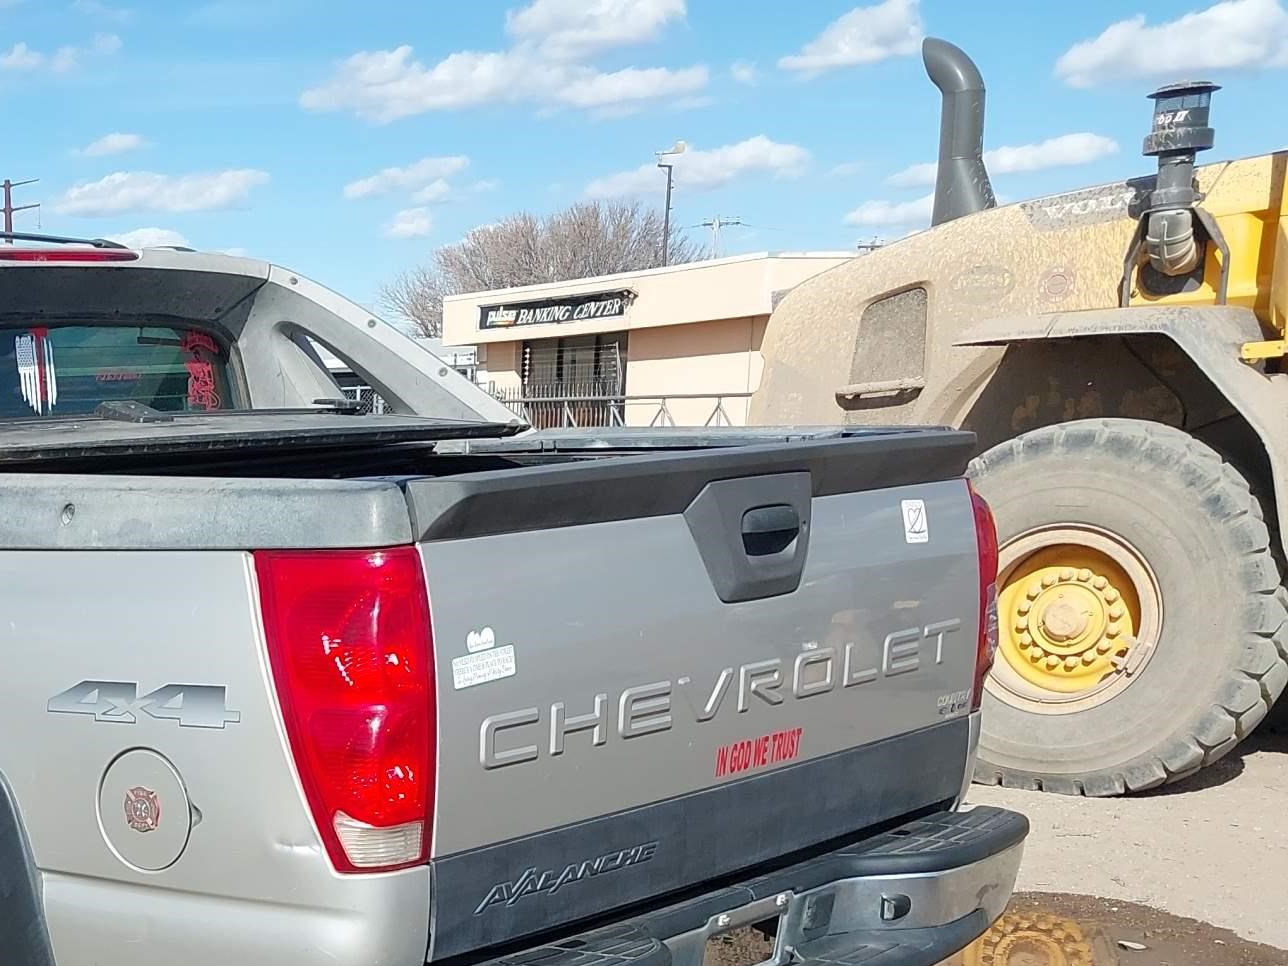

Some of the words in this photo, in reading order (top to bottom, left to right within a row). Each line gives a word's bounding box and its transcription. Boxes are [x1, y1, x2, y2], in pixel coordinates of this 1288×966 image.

[518, 304, 571, 325] BANKING
[573, 298, 621, 319] CENTER
[479, 617, 961, 770] CHEVROLET
[715, 746, 729, 777] IN
[730, 740, 752, 774] GOD
[753, 735, 769, 768] WE
[770, 727, 802, 763] TRUST
[472, 840, 659, 916] AVALANCHE
